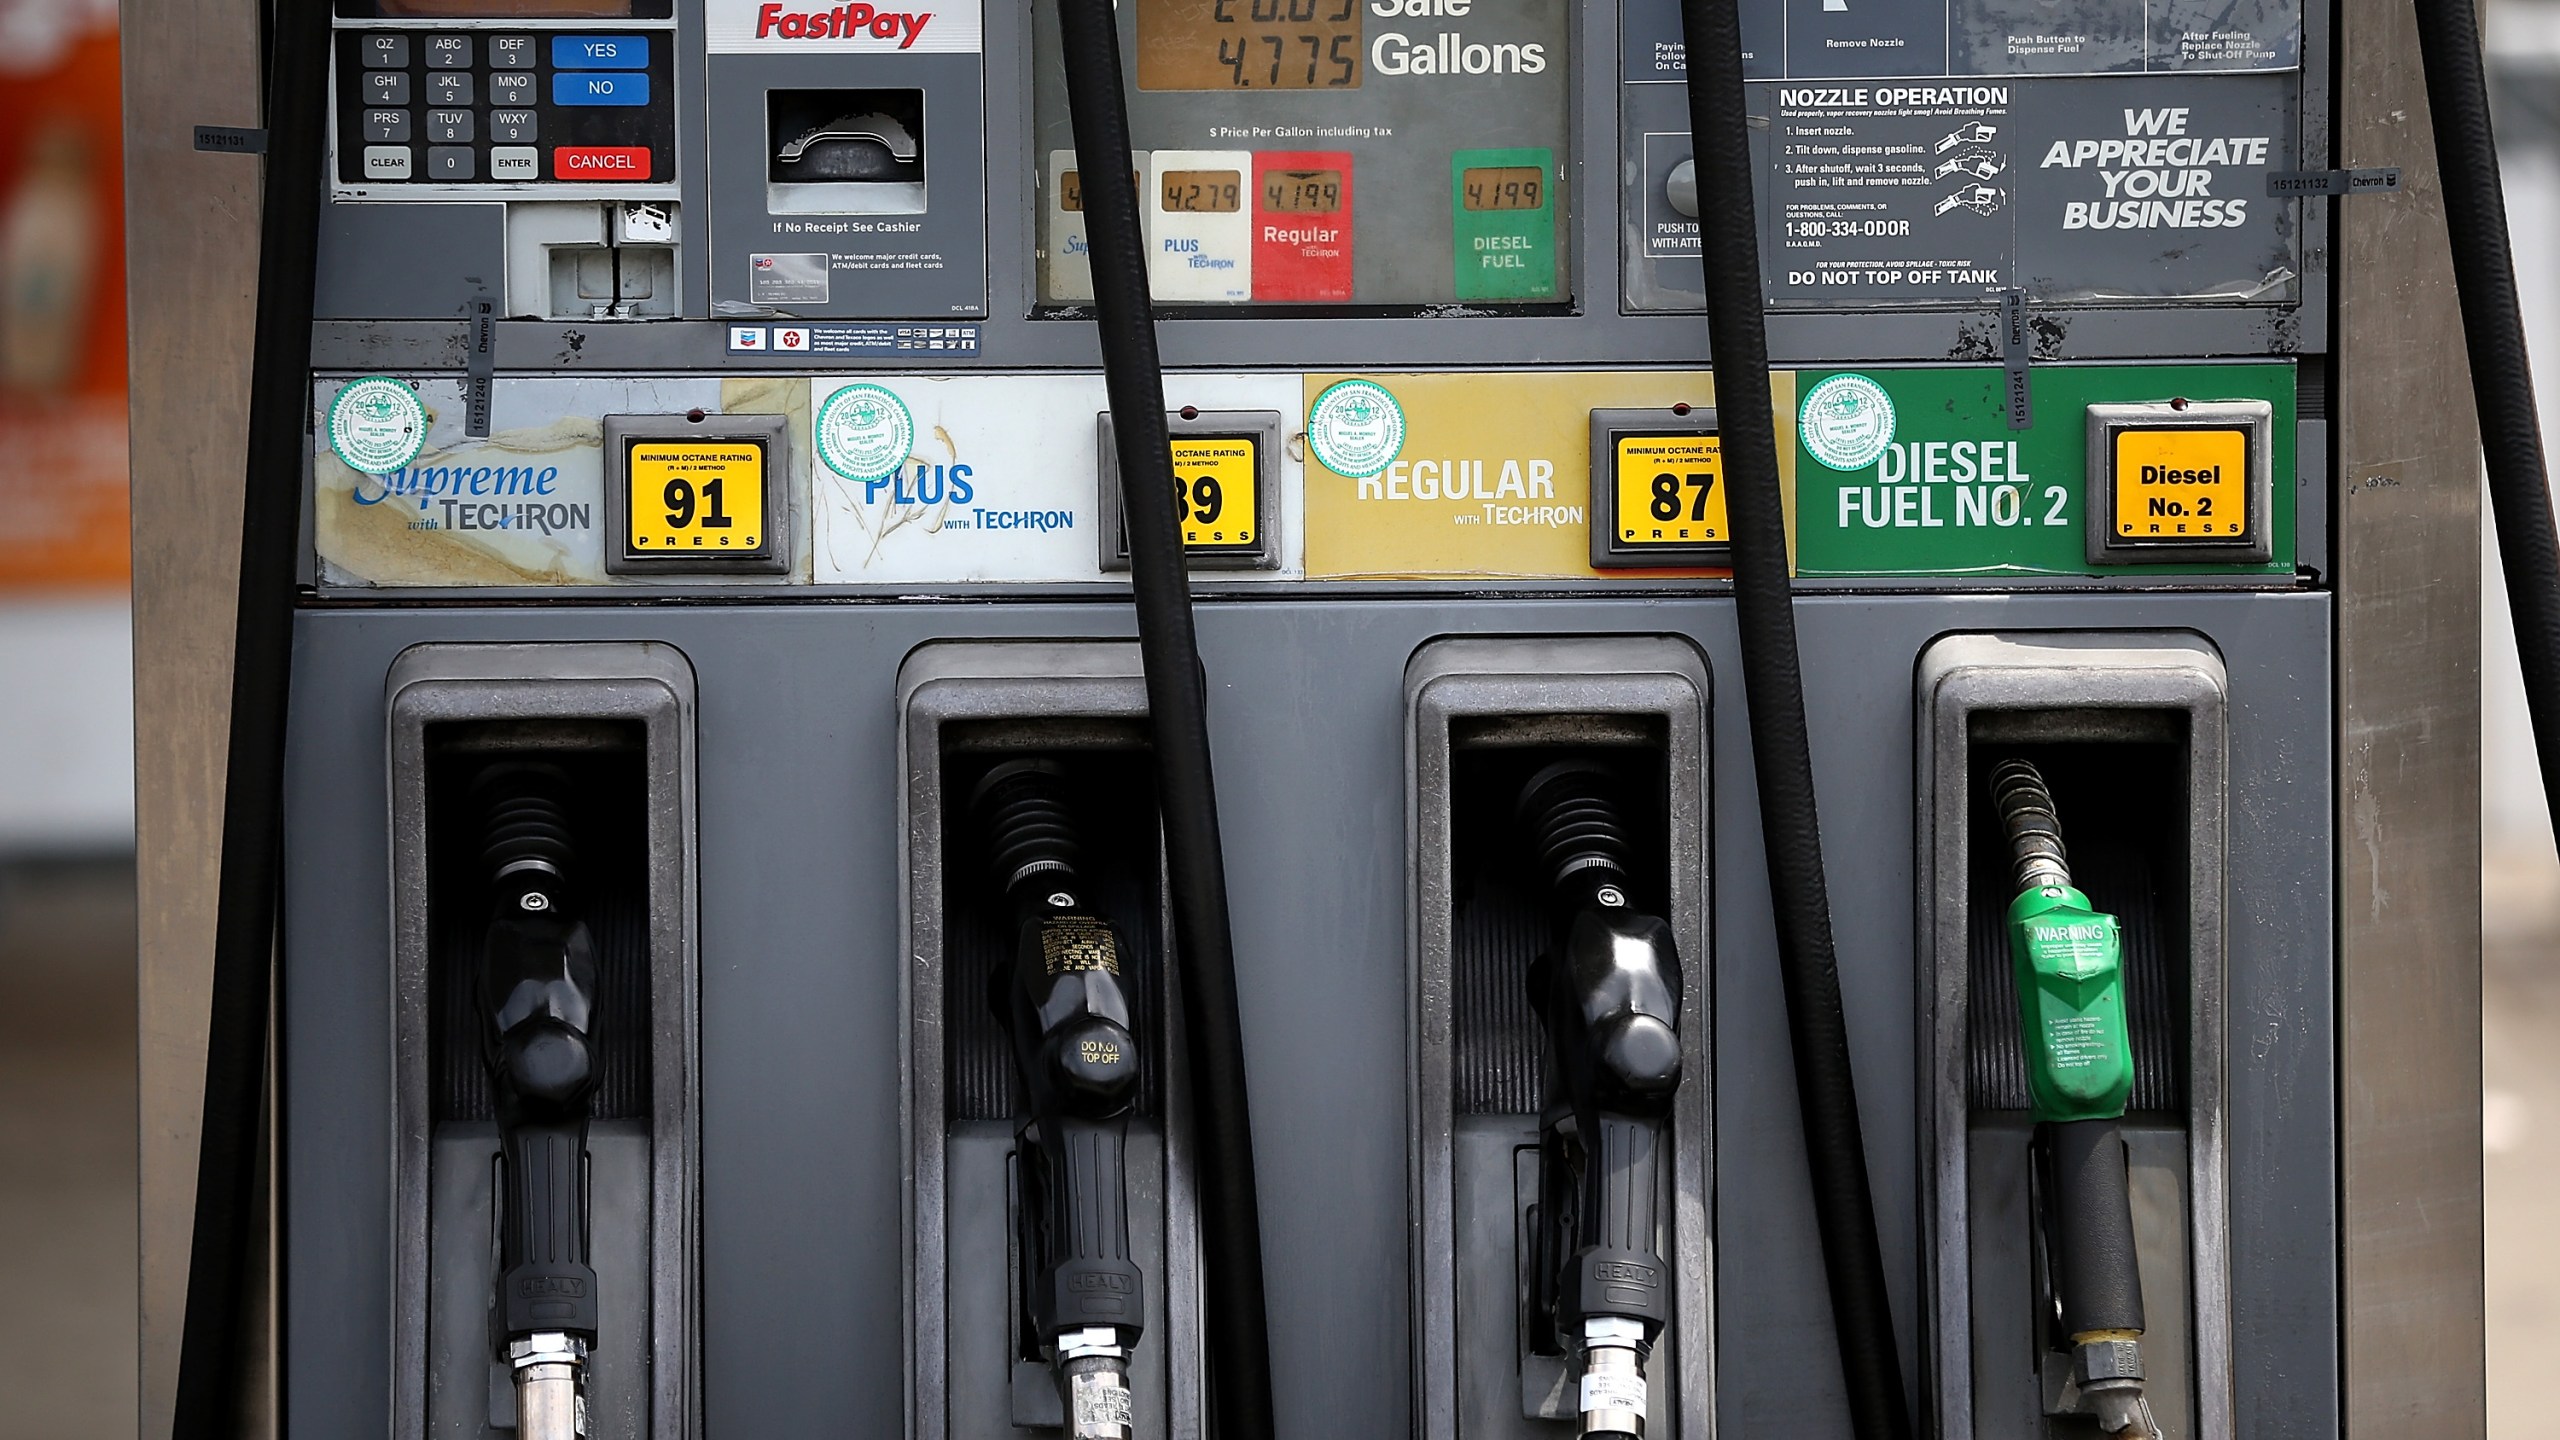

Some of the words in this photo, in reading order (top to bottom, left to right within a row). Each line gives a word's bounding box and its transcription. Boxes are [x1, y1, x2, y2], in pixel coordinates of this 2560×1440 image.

[756, 3, 932, 49] FastPay
[1827, 39, 1867, 48] Remove
[1869, 38, 1904, 47] Nozzle
[2008, 36, 2033, 44] Push
[2036, 36, 2072, 44] Button
[2182, 32, 2210, 41] After
[2212, 31, 2251, 42] Fueling
[376, 39, 394, 50] QZ
[435, 38, 462, 50] ABC
[500, 39, 524, 50] DEF
[583, 43, 617, 58] YES
[2008, 46, 2055, 55] Dispense
[2058, 45, 2080, 53] Fuel
[2182, 42, 2223, 52] Replace
[2226, 41, 2261, 50] Nozzle
[1371, 32, 1546, 75] Gallons
[2182, 51, 2196, 60] To
[2198, 51, 2244, 60] Shut-Off
[2246, 50, 2276, 60] Pump
[1219, 35, 1353, 86] 4.775
[1655, 62, 1670, 70] On
[374, 76, 397, 87] GHI
[438, 76, 460, 87] JKL
[498, 76, 528, 87] MNO
[589, 81, 613, 95] NO
[1780, 89, 1868, 107] NOZZLE
[1875, 87, 2008, 106] OPERATION
[373, 113, 400, 124] PRS
[437, 113, 463, 124] TUV
[498, 113, 528, 124] WXY
[2124, 108, 2190, 135] WE
[510, 128, 517, 138] 9
[1210, 127, 1217, 138] $
[1220, 127, 1249, 137] Price
[1252, 127, 1272, 137] Per
[1275, 127, 1314, 137] Gallon
[1316, 126, 1371, 139] including
[1374, 127, 1392, 137] tax
[1786, 127, 1793, 135] 1.
[1796, 126, 1821, 135] Insert
[1824, 126, 1854, 135] nozzle.
[199, 135, 244, 146] 15121131
[1786, 146, 1793, 154] 2.
[1796, 145, 1810, 154] Tilt
[1812, 145, 1839, 155] down,
[1842, 145, 1883, 156] dispense
[1885, 144, 1926, 155] gasoline.
[2040, 137, 2270, 169] APPRECIATE
[371, 158, 405, 168] CLEAR
[447, 157, 455, 168] 0
[498, 158, 531, 168] ENTER
[568, 155, 636, 169] CANCEL
[1785, 164, 1793, 173] 3.
[1795, 164, 1818, 173] After
[1820, 164, 1853, 174] shutoff,
[1856, 164, 1876, 173] wait
[1878, 164, 1883, 173] 3
[1885, 163, 1925, 174] seconds,
[1795, 178, 1816, 188] push
[1819, 177, 1830, 187] in,
[1832, 177, 1845, 186] lift
[1847, 177, 1864, 186] and
[1865, 178, 1899, 186] remove
[1901, 176, 1932, 186] nozzle.
[2101, 169, 2213, 198] YOUR
[2273, 179, 2328, 190] 15121132
[2353, 177, 2384, 187] Chevron
[2063, 200, 2247, 229] BUSINESS
[773, 222, 781, 233] If
[785, 223, 801, 233] No
[805, 222, 848, 234] Receipt
[852, 222, 873, 233] See
[877, 222, 921, 232] Cashier
[1658, 223, 1684, 233] PUSH
[1686, 223, 1699, 233] TO
[1785, 220, 1910, 237] 1-800-334-ODOR
[1264, 226, 1338, 246] Regular
[1164, 239, 1199, 252] PLUS
[1474, 236, 1532, 250] DIESEL
[1652, 238, 1678, 248] WITH
[876, 253, 896, 262] major
[920, 253, 942, 261] cards,
[1482, 255, 1525, 268] FUEL
[1789, 272, 1816, 285] DO
[1821, 271, 1860, 285] NOT
[1865, 271, 1902, 284] TOP
[1908, 270, 1942, 284] OFF
[1950, 270, 1998, 284] TANK
[2011, 309, 2021, 345] Chevron
[478, 317, 489, 353] Chevron
[1859, 397, 1868, 405] 12
[2013, 370, 2025, 423] 15121241
[473, 378, 486, 430] 15121240
[720, 454, 752, 462] RATING
[1878, 440, 2029, 484] DIESEL
[1357, 459, 1555, 500] REGULAR
[2141, 465, 2220, 484] Diesel
[865, 465, 974, 505] PLUS
[663, 478, 732, 529] 91
[1650, 473, 1714, 522] 87
[1839, 487, 1944, 528] FUEL
[1955, 486, 2032, 527] NO.
[2043, 486, 2068, 525] 2
[2149, 497, 2190, 517] No.
[2197, 497, 2213, 516] 2
[408, 517, 438, 531] with
[439, 499, 590, 536] TECHRON
[944, 519, 970, 529] WITH
[973, 508, 1073, 533] TECHRON
[1454, 514, 1480, 525] WITH
[1483, 503, 1583, 528] TECHRON
[1625, 529, 1716, 539] PRES
[2123, 524, 2239, 533] PRESS
[639, 536, 755, 546] PRESS
[2035, 925, 2104, 941] WARNING
[1081, 1042, 1096, 1052] DO
[1082, 1052, 1100, 1063] TOP
[1102, 1053, 1120, 1064] OFF
[1600, 1264, 1655, 1283] HEALY
[522, 1280, 581, 1295] HEALY
[1072, 1276, 1130, 1290] HEALY
